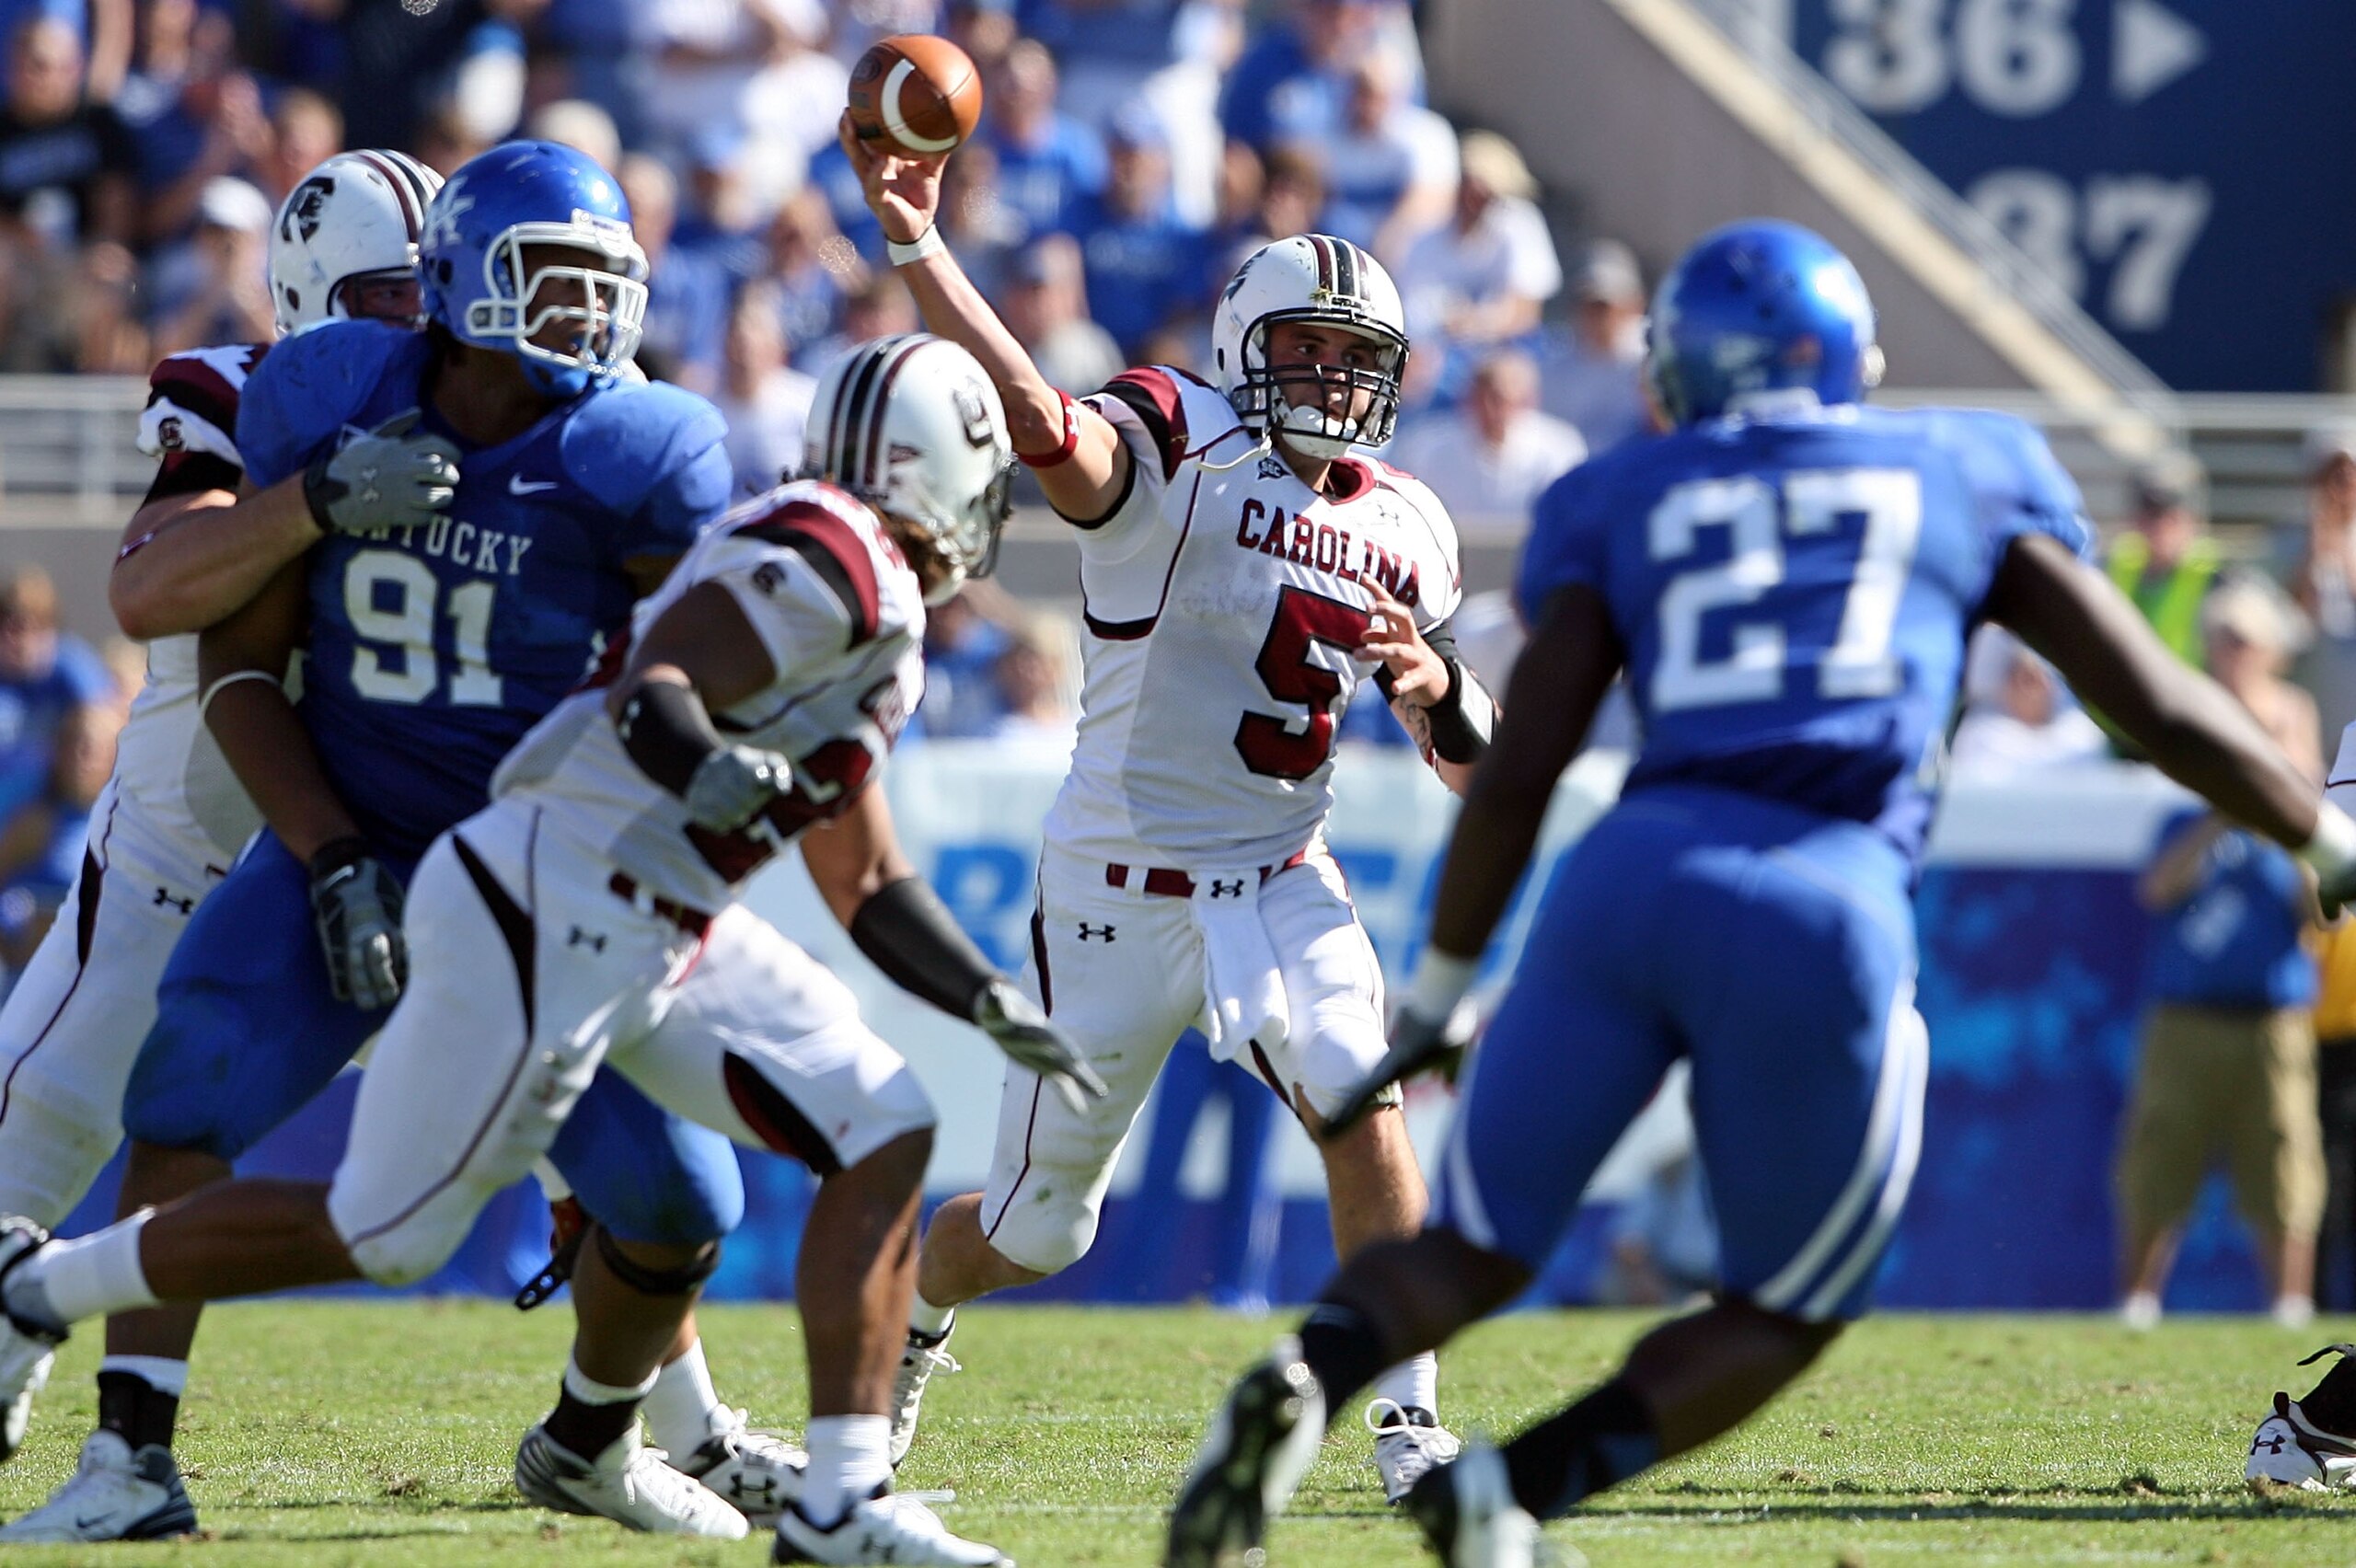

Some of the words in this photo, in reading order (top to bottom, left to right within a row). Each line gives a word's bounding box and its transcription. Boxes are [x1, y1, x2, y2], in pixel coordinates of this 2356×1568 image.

[345, 513, 533, 575] TUCKY
[1237, 498, 1420, 607] CAROLINA
[1648, 470, 1922, 712] 27
[344, 549, 503, 706] 91
[1234, 583, 1373, 781] 5
